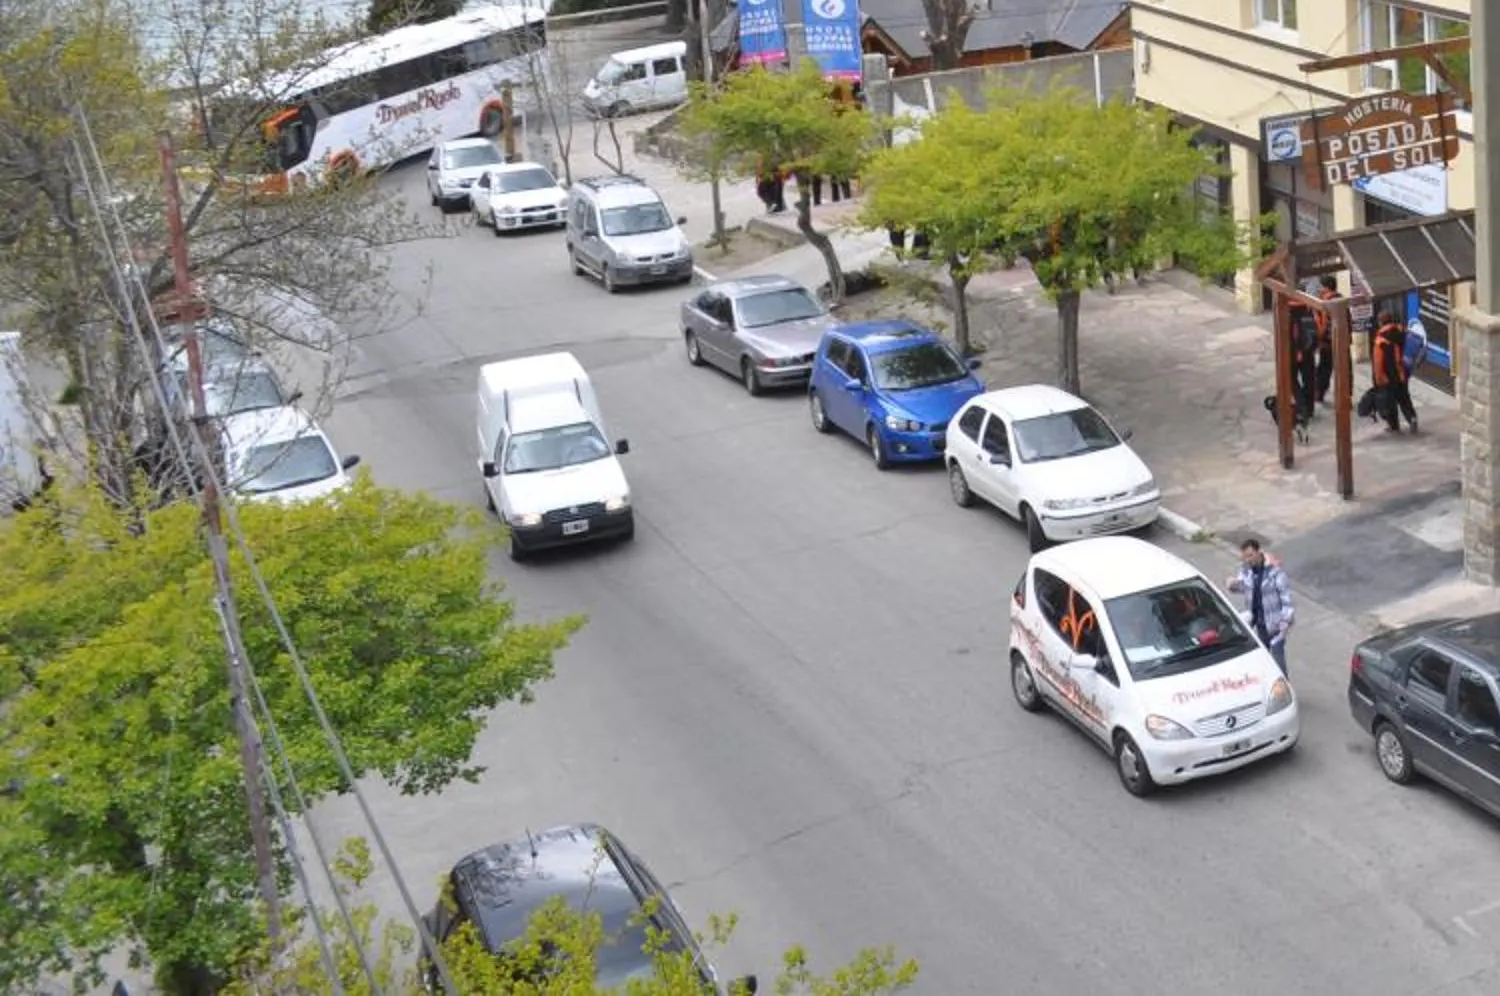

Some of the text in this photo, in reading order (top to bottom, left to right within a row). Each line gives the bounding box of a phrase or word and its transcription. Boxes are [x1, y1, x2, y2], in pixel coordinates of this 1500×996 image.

[1343, 96, 1414, 126] HOSTERIA
[1328, 120, 1435, 159] POSADA
[1326, 157, 1379, 185] DEL
[1392, 145, 1442, 170] SOL
